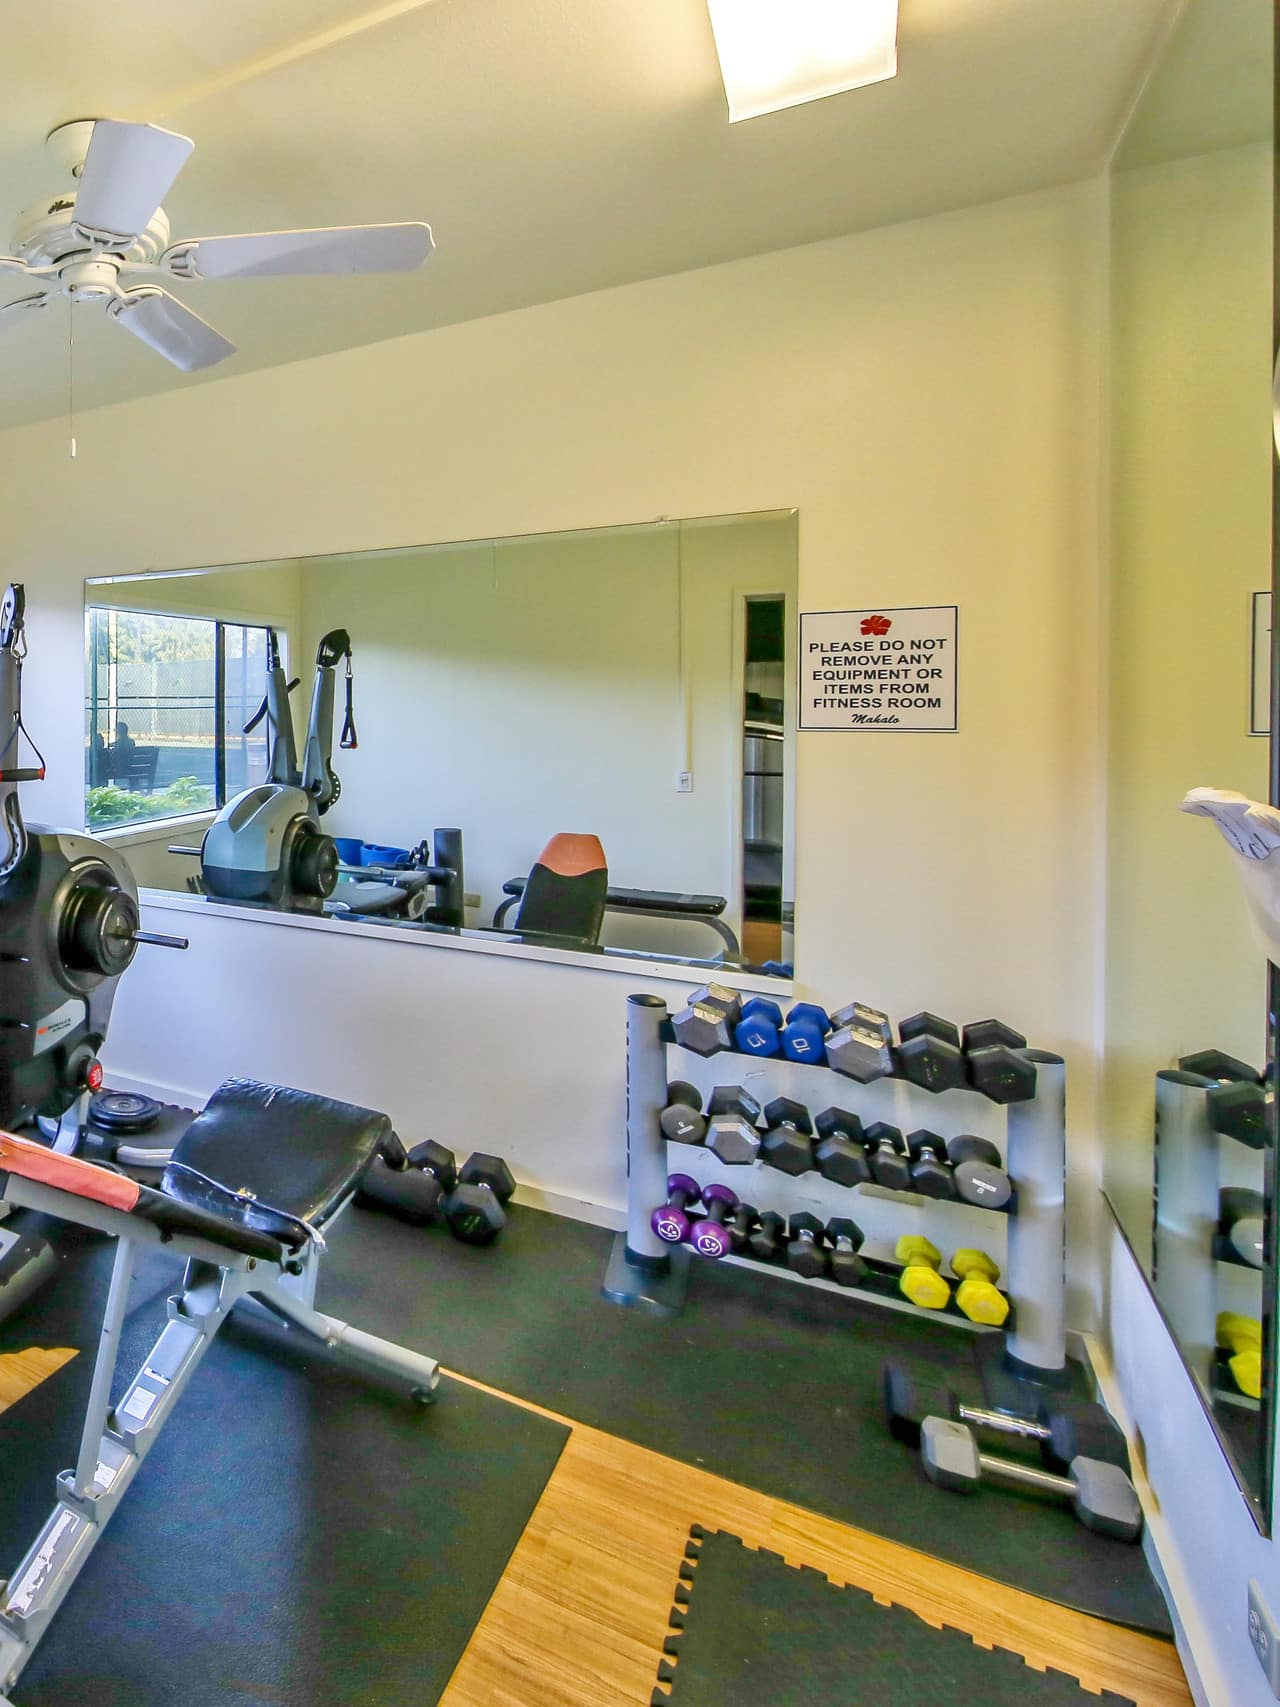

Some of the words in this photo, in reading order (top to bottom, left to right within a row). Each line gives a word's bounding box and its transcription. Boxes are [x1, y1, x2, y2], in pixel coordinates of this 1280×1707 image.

[809, 641, 874, 653] PLEASE
[880, 640, 905, 651] DO
[910, 638, 947, 650] NOT
[821, 655, 892, 667] REMOVE
[897, 654, 934, 665] ANY
[812, 669, 911, 681] EQUIPMENT
[916, 668, 943, 679] OR
[824, 684, 874, 695] ITEMS
[879, 683, 929, 694] FROM
[813, 698, 882, 709] FITNESS
[887, 698, 941, 709] ROOM
[851, 713, 900, 724] Mahalo
